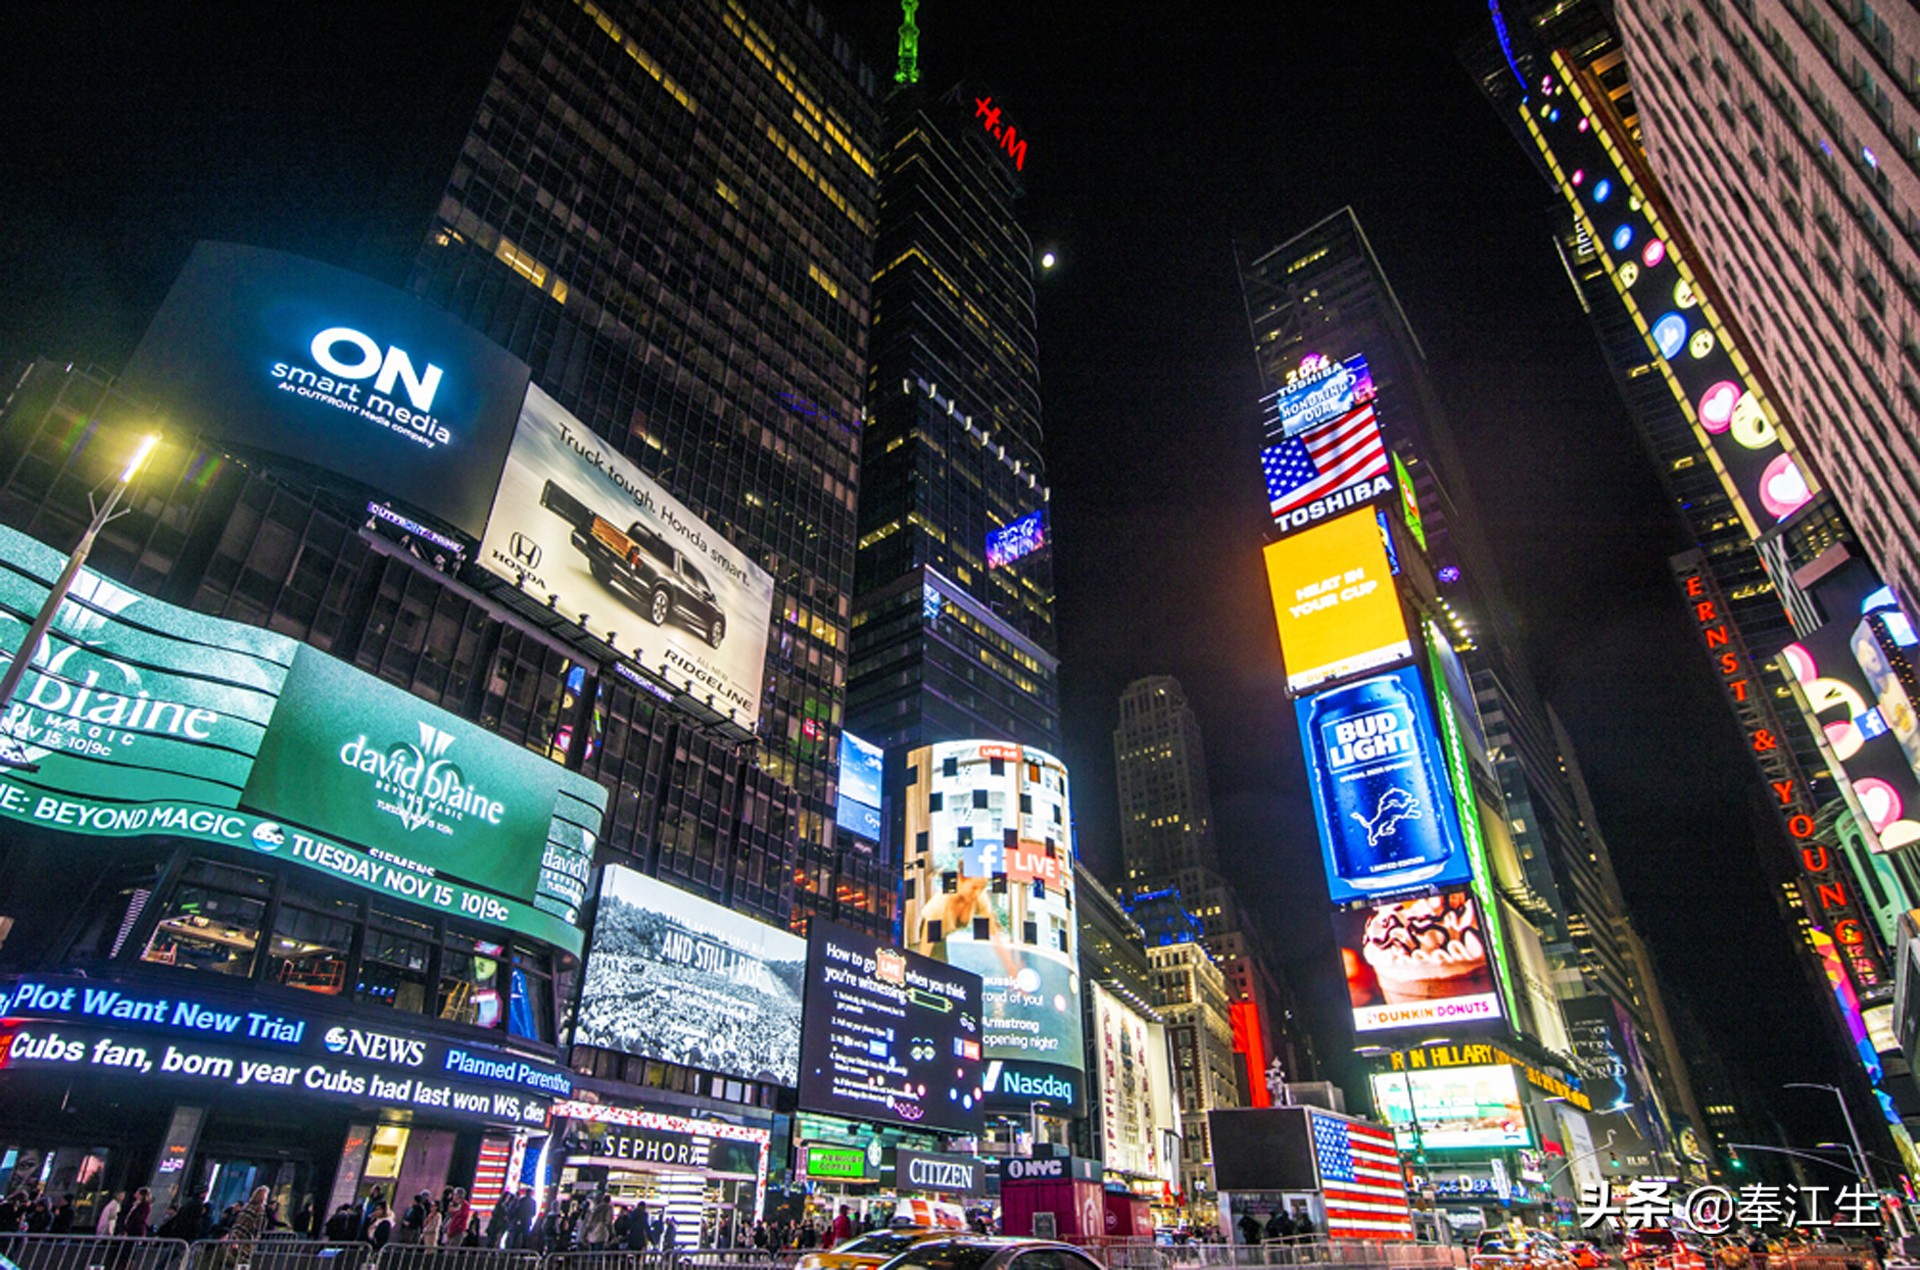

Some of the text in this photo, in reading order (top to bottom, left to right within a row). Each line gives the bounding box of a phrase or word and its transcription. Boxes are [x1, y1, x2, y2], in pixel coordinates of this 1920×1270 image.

[975, 97, 1028, 171] H&M
[311, 327, 443, 413] ON
[1278, 362, 1343, 396] TOSHIBA
[271, 362, 450, 444] smart media
[278, 381, 434, 448] An OUTFRONT Media company
[559, 422, 751, 587] Truck tough. Honda smart.
[1274, 475, 1392, 532] TOSHIBA
[491, 549, 546, 589] HONDA
[1296, 567, 1365, 601] HEAT IN
[1289, 580, 1378, 618] YOUR CUP
[1686, 576, 1748, 702] ERNST
[664, 649, 753, 711] RIDGELINE
[44, 713, 135, 747] MAGIC
[44, 729, 62, 746] 15
[1335, 712, 1398, 743] BUD
[1753, 729, 1777, 751] &
[1330, 730, 1413, 768] LIGHT
[340, 735, 504, 824] david blaine
[428, 800, 463, 820] MAGIC
[34, 797, 148, 830] BEYOND
[151, 808, 245, 838] MAGIC
[292, 834, 384, 884] TUESDAY
[385, 867, 430, 906] NOV
[434, 885, 455, 906] 15
[1015, 852, 1056, 878] LIVE
[1772, 780, 1864, 946] YOUNG
[661, 930, 692, 963] AND
[694, 940, 727, 975] STILL
[826, 942, 851, 961] How
[852, 952, 863, 967] to
[863, 958, 876, 973] go
[905, 970, 928, 988] when
[929, 979, 945, 994] you
[946, 981, 967, 1001] think
[825, 966, 857, 986] you're
[858, 975, 907, 1006] witnessing
[1010, 991, 1023, 1004] of
[12, 983, 77, 1011] Plot
[82, 989, 168, 1022] Want
[172, 1002, 241, 1033] New
[248, 1013, 306, 1043] Trial
[1438, 1001, 1490, 1017] DONUTS
[346, 1029, 426, 1066] NEWS
[446, 1049, 517, 1081] Planned
[1409, 1048, 1427, 1069] IN
[1430, 1044, 1493, 1067] HILLARY
[9, 1031, 546, 1123] Cubs fan, born year Cubs had last won WS, dies
[1003, 1071, 1073, 1105] Nasdaq
[604, 1135, 699, 1165] SEPHORA
[1025, 1160, 1063, 1177] NYC
[909, 1158, 974, 1189] CITIZEN
